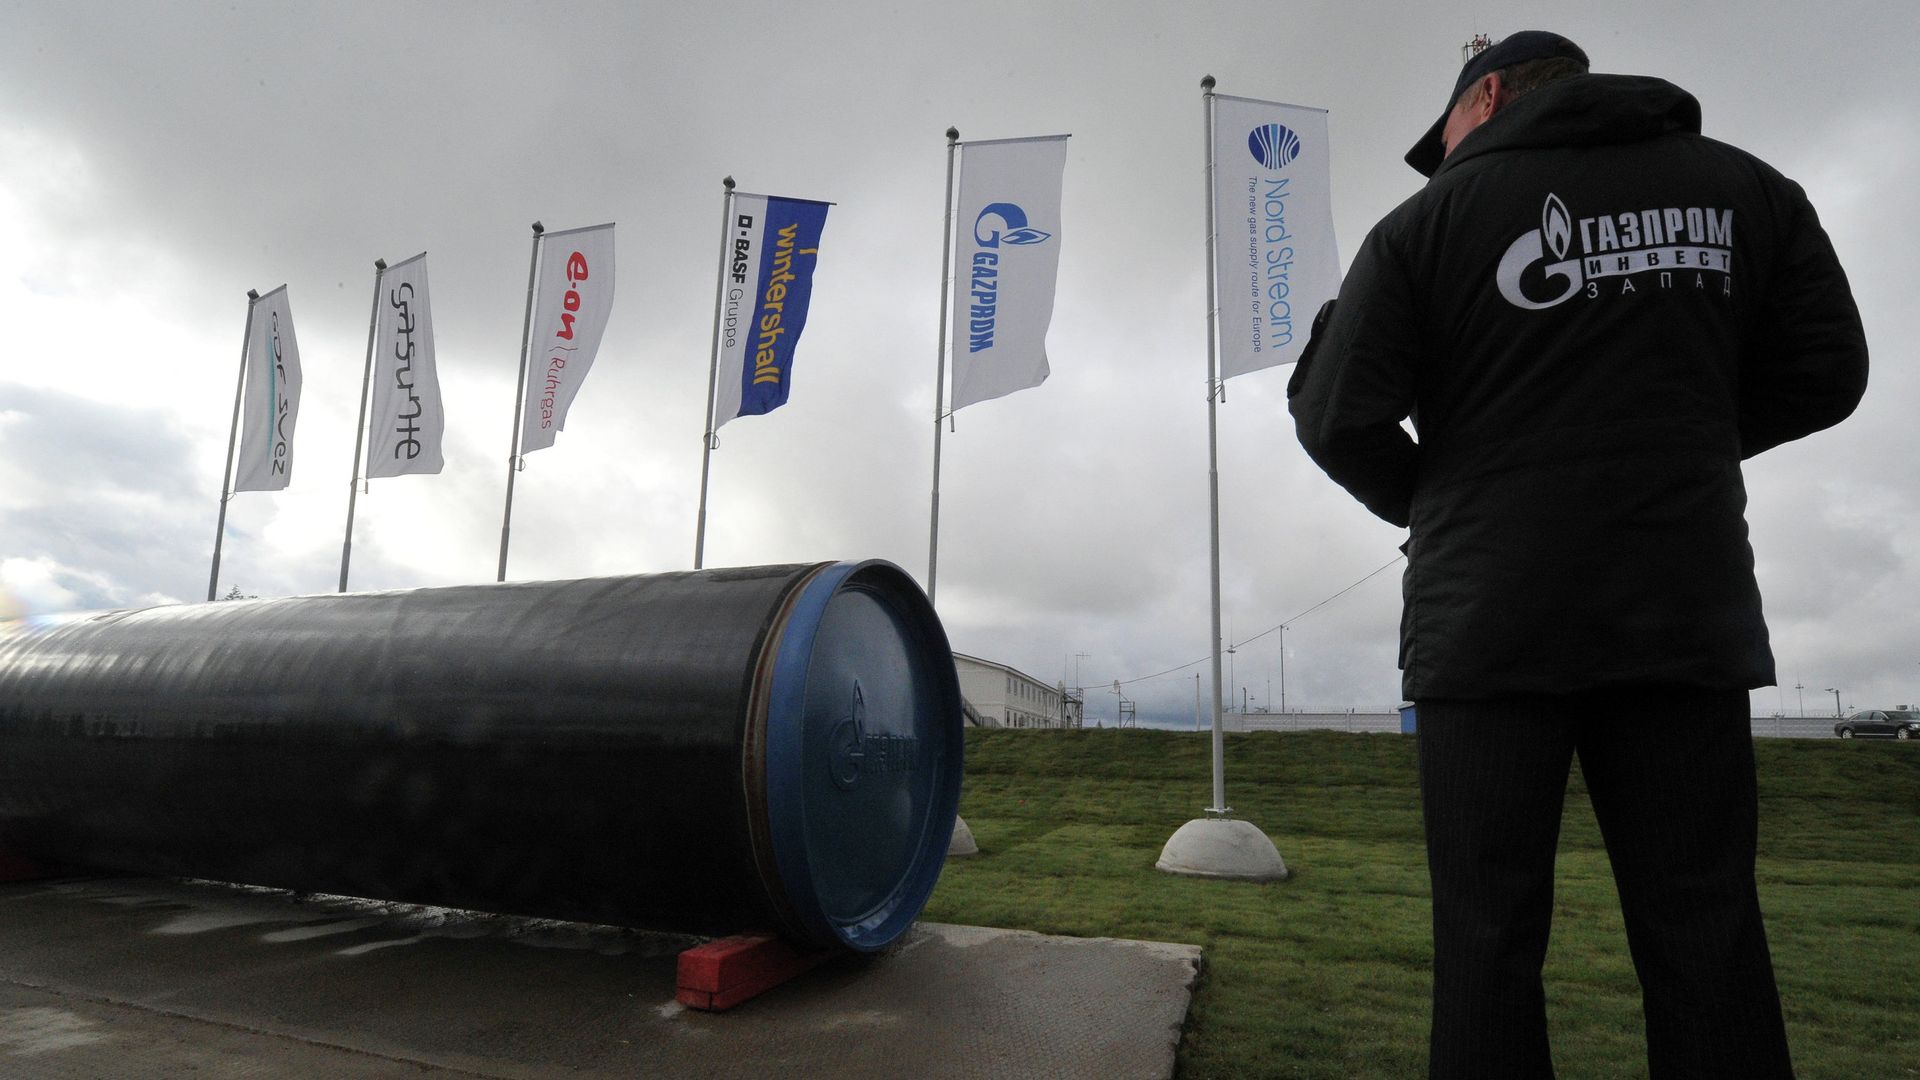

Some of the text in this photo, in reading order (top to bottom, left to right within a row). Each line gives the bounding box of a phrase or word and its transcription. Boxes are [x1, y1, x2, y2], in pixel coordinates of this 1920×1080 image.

[1248, 176, 1257, 193] The
[1248, 195, 1257, 216] new
[1247, 217, 1257, 235] gas
[1580, 207, 1734, 254] ГАЗПРОМ
[1248, 236, 1258, 269] supply
[1264, 178, 1294, 348] Nord Stream
[1589, 250, 1729, 275] ИНВЕСТ
[725, 238, 750, 348] BASF Gruppe
[1251, 271, 1259, 298] route
[1586, 271, 1732, 299] ЗАПАД
[753, 223, 800, 385] wintershall
[969, 252, 999, 353] GAZPROM
[1252, 317, 1262, 353] Europe
[540, 357, 566, 430] Ruhrgas
